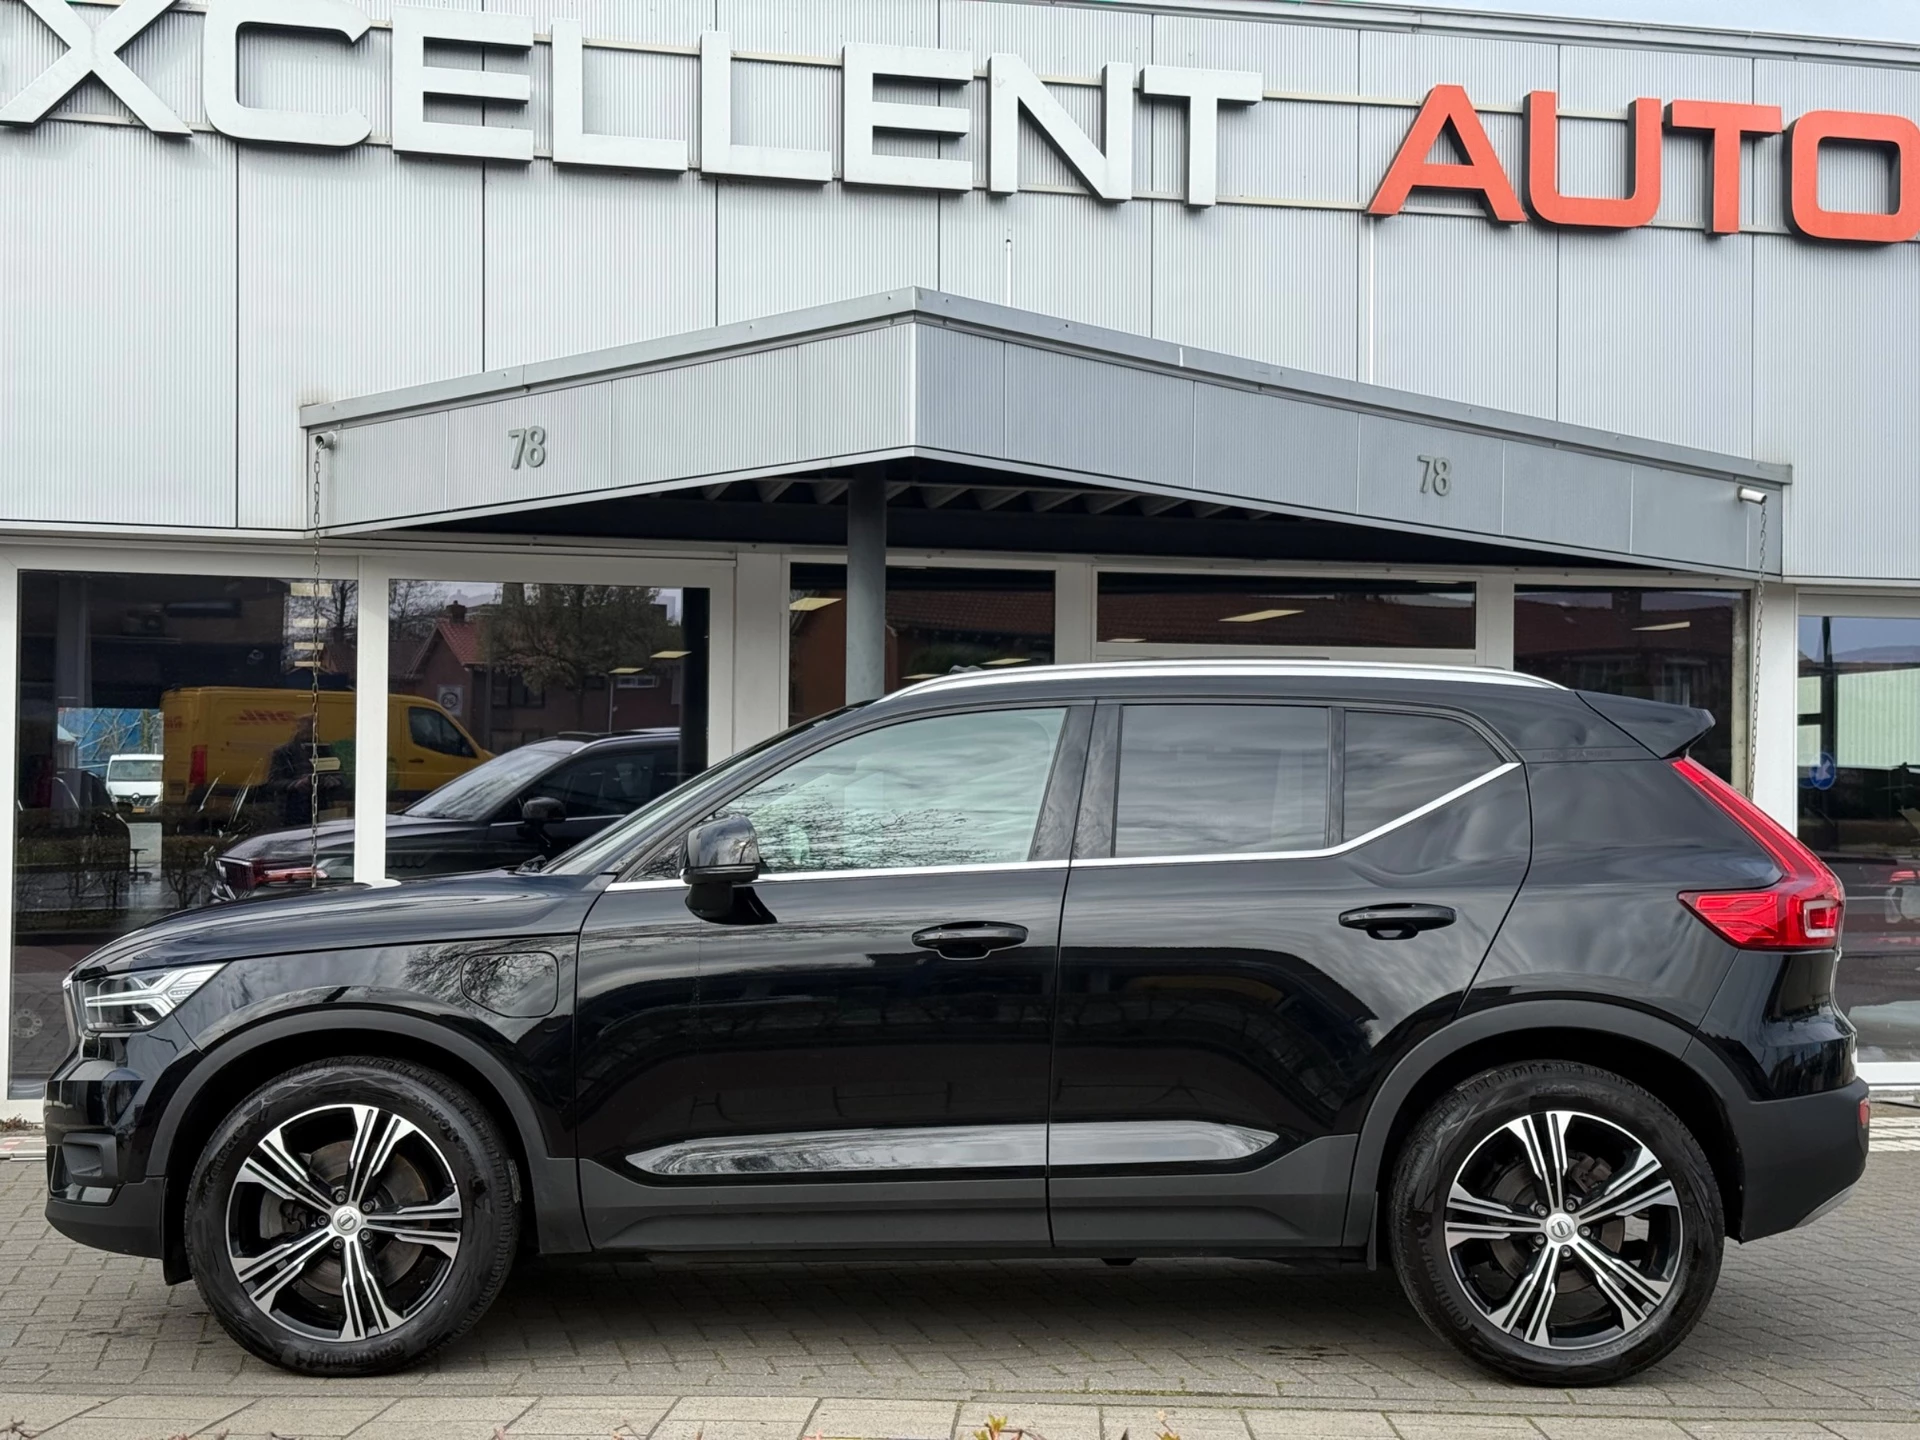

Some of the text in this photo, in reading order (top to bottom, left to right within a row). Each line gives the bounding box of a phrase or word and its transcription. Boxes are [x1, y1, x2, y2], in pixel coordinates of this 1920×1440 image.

[0, 0, 1920, 243] XCELLENT AUTO
[507, 426, 546, 470] 78
[1417, 455, 1452, 496] 78
